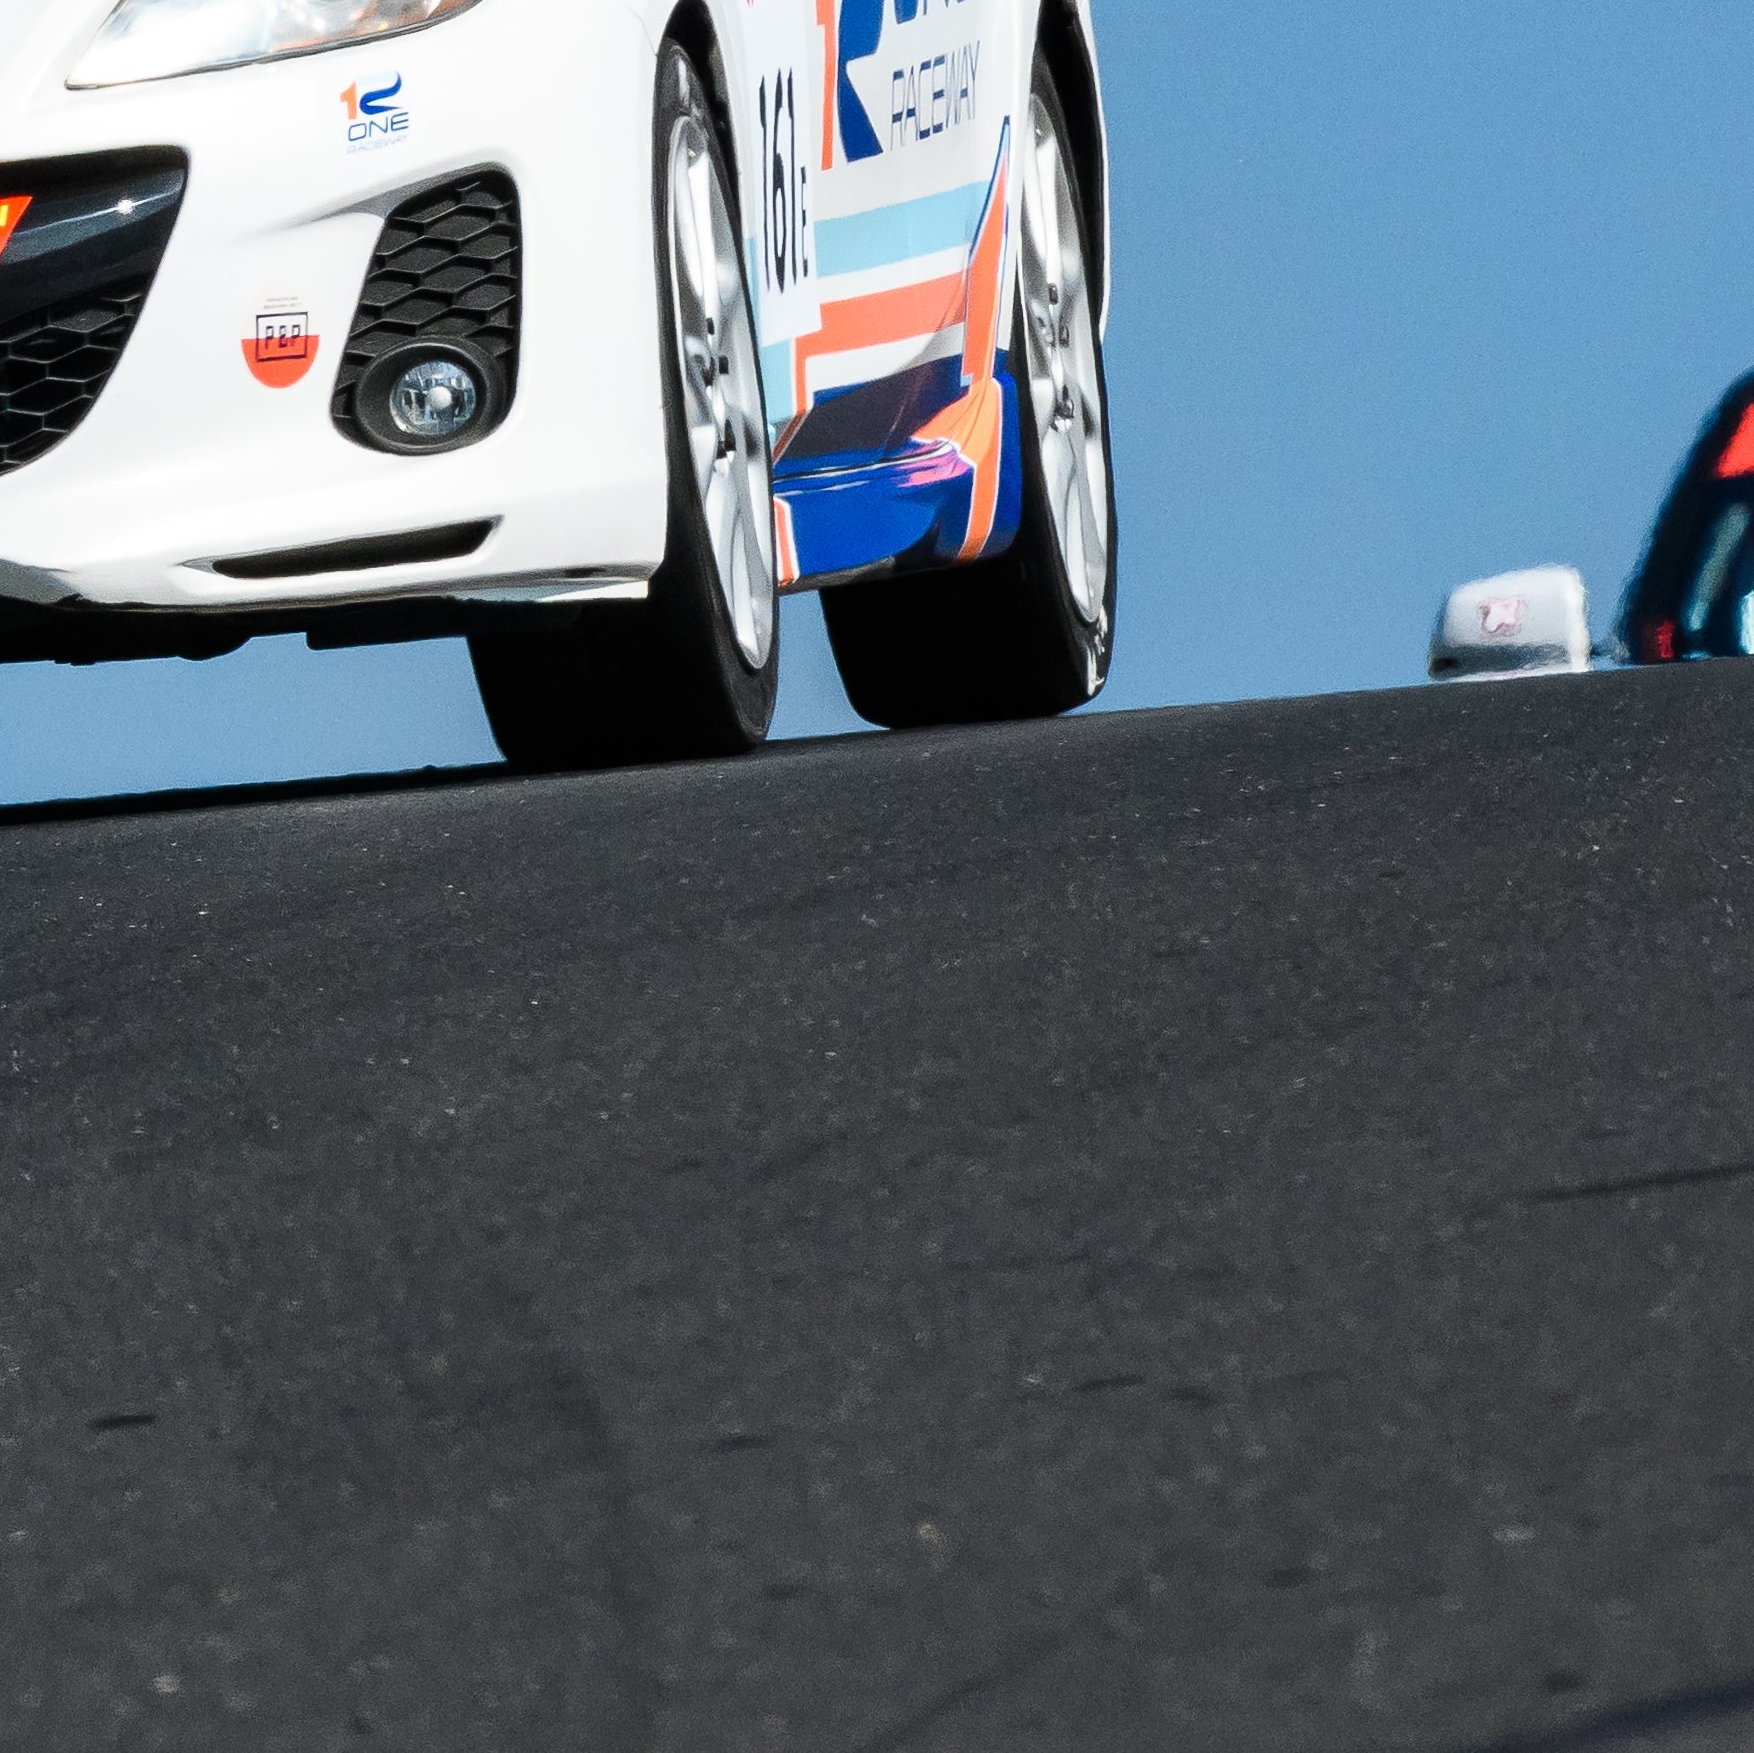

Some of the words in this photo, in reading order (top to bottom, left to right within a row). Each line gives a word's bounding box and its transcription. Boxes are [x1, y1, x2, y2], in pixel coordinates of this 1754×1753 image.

[348, 112, 409, 141] ONE
[890, 40, 980, 150] RACEWAY
[759, 67, 796, 295] 161
